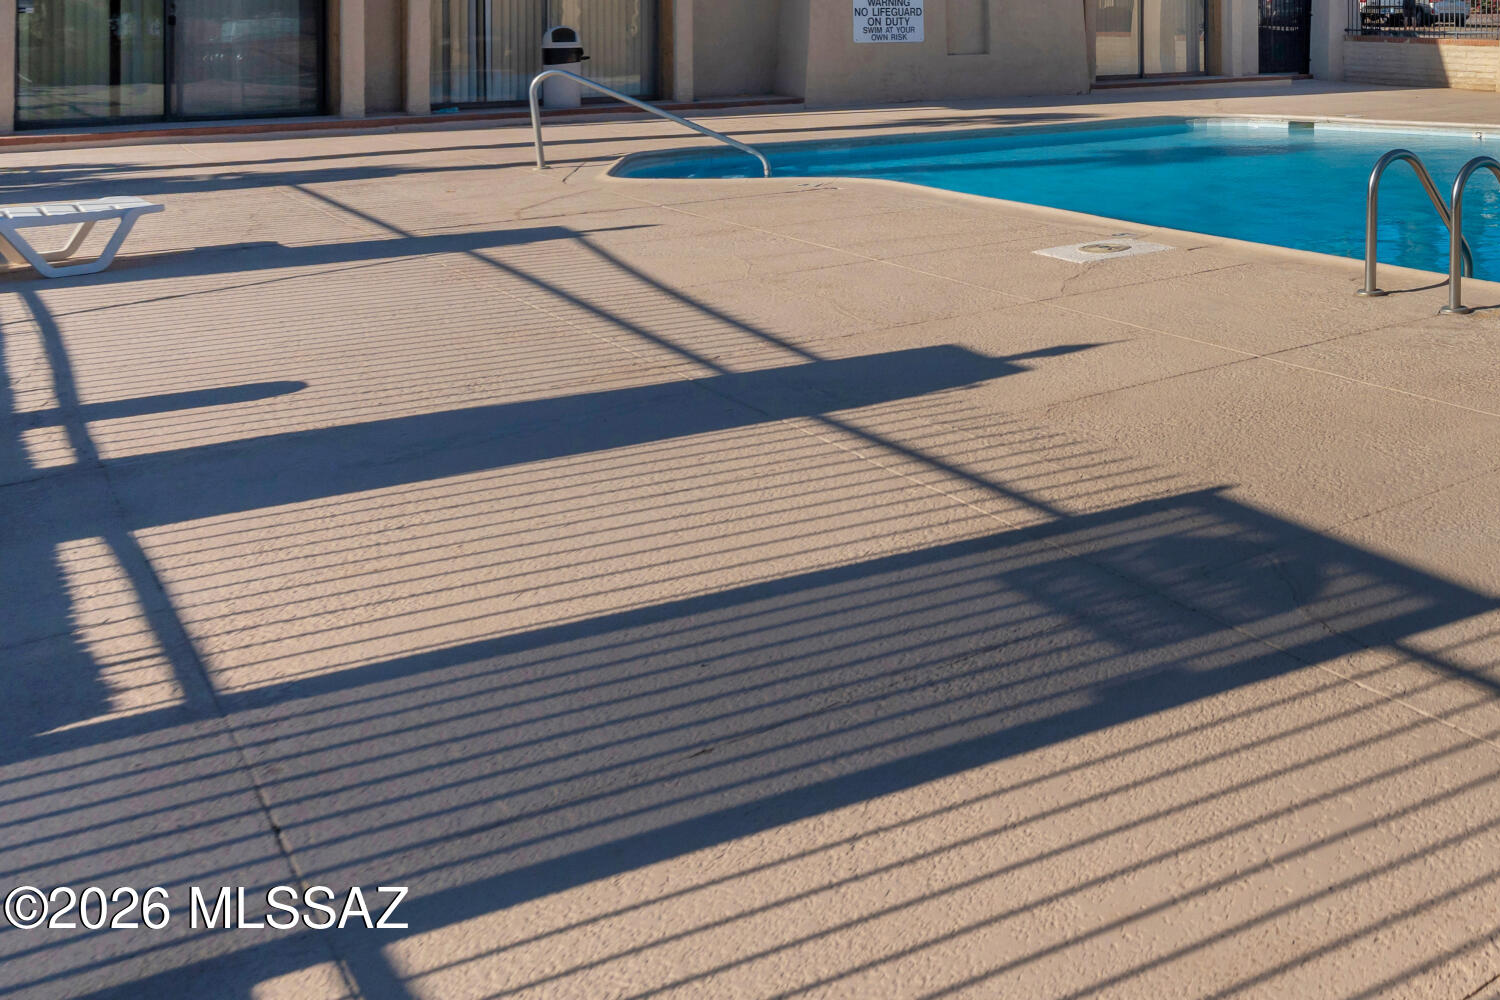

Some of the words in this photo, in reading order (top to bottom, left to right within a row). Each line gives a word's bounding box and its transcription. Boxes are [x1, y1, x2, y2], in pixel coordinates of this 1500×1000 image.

[854, 8, 868, 17] NO
[872, 8, 923, 17] LIFEGUARD
[867, 17, 882, 26] ON
[885, 17, 910, 26] DUTY
[863, 26, 882, 34] SWIM
[885, 26, 894, 34] AT
[896, 26, 916, 34] YOUR
